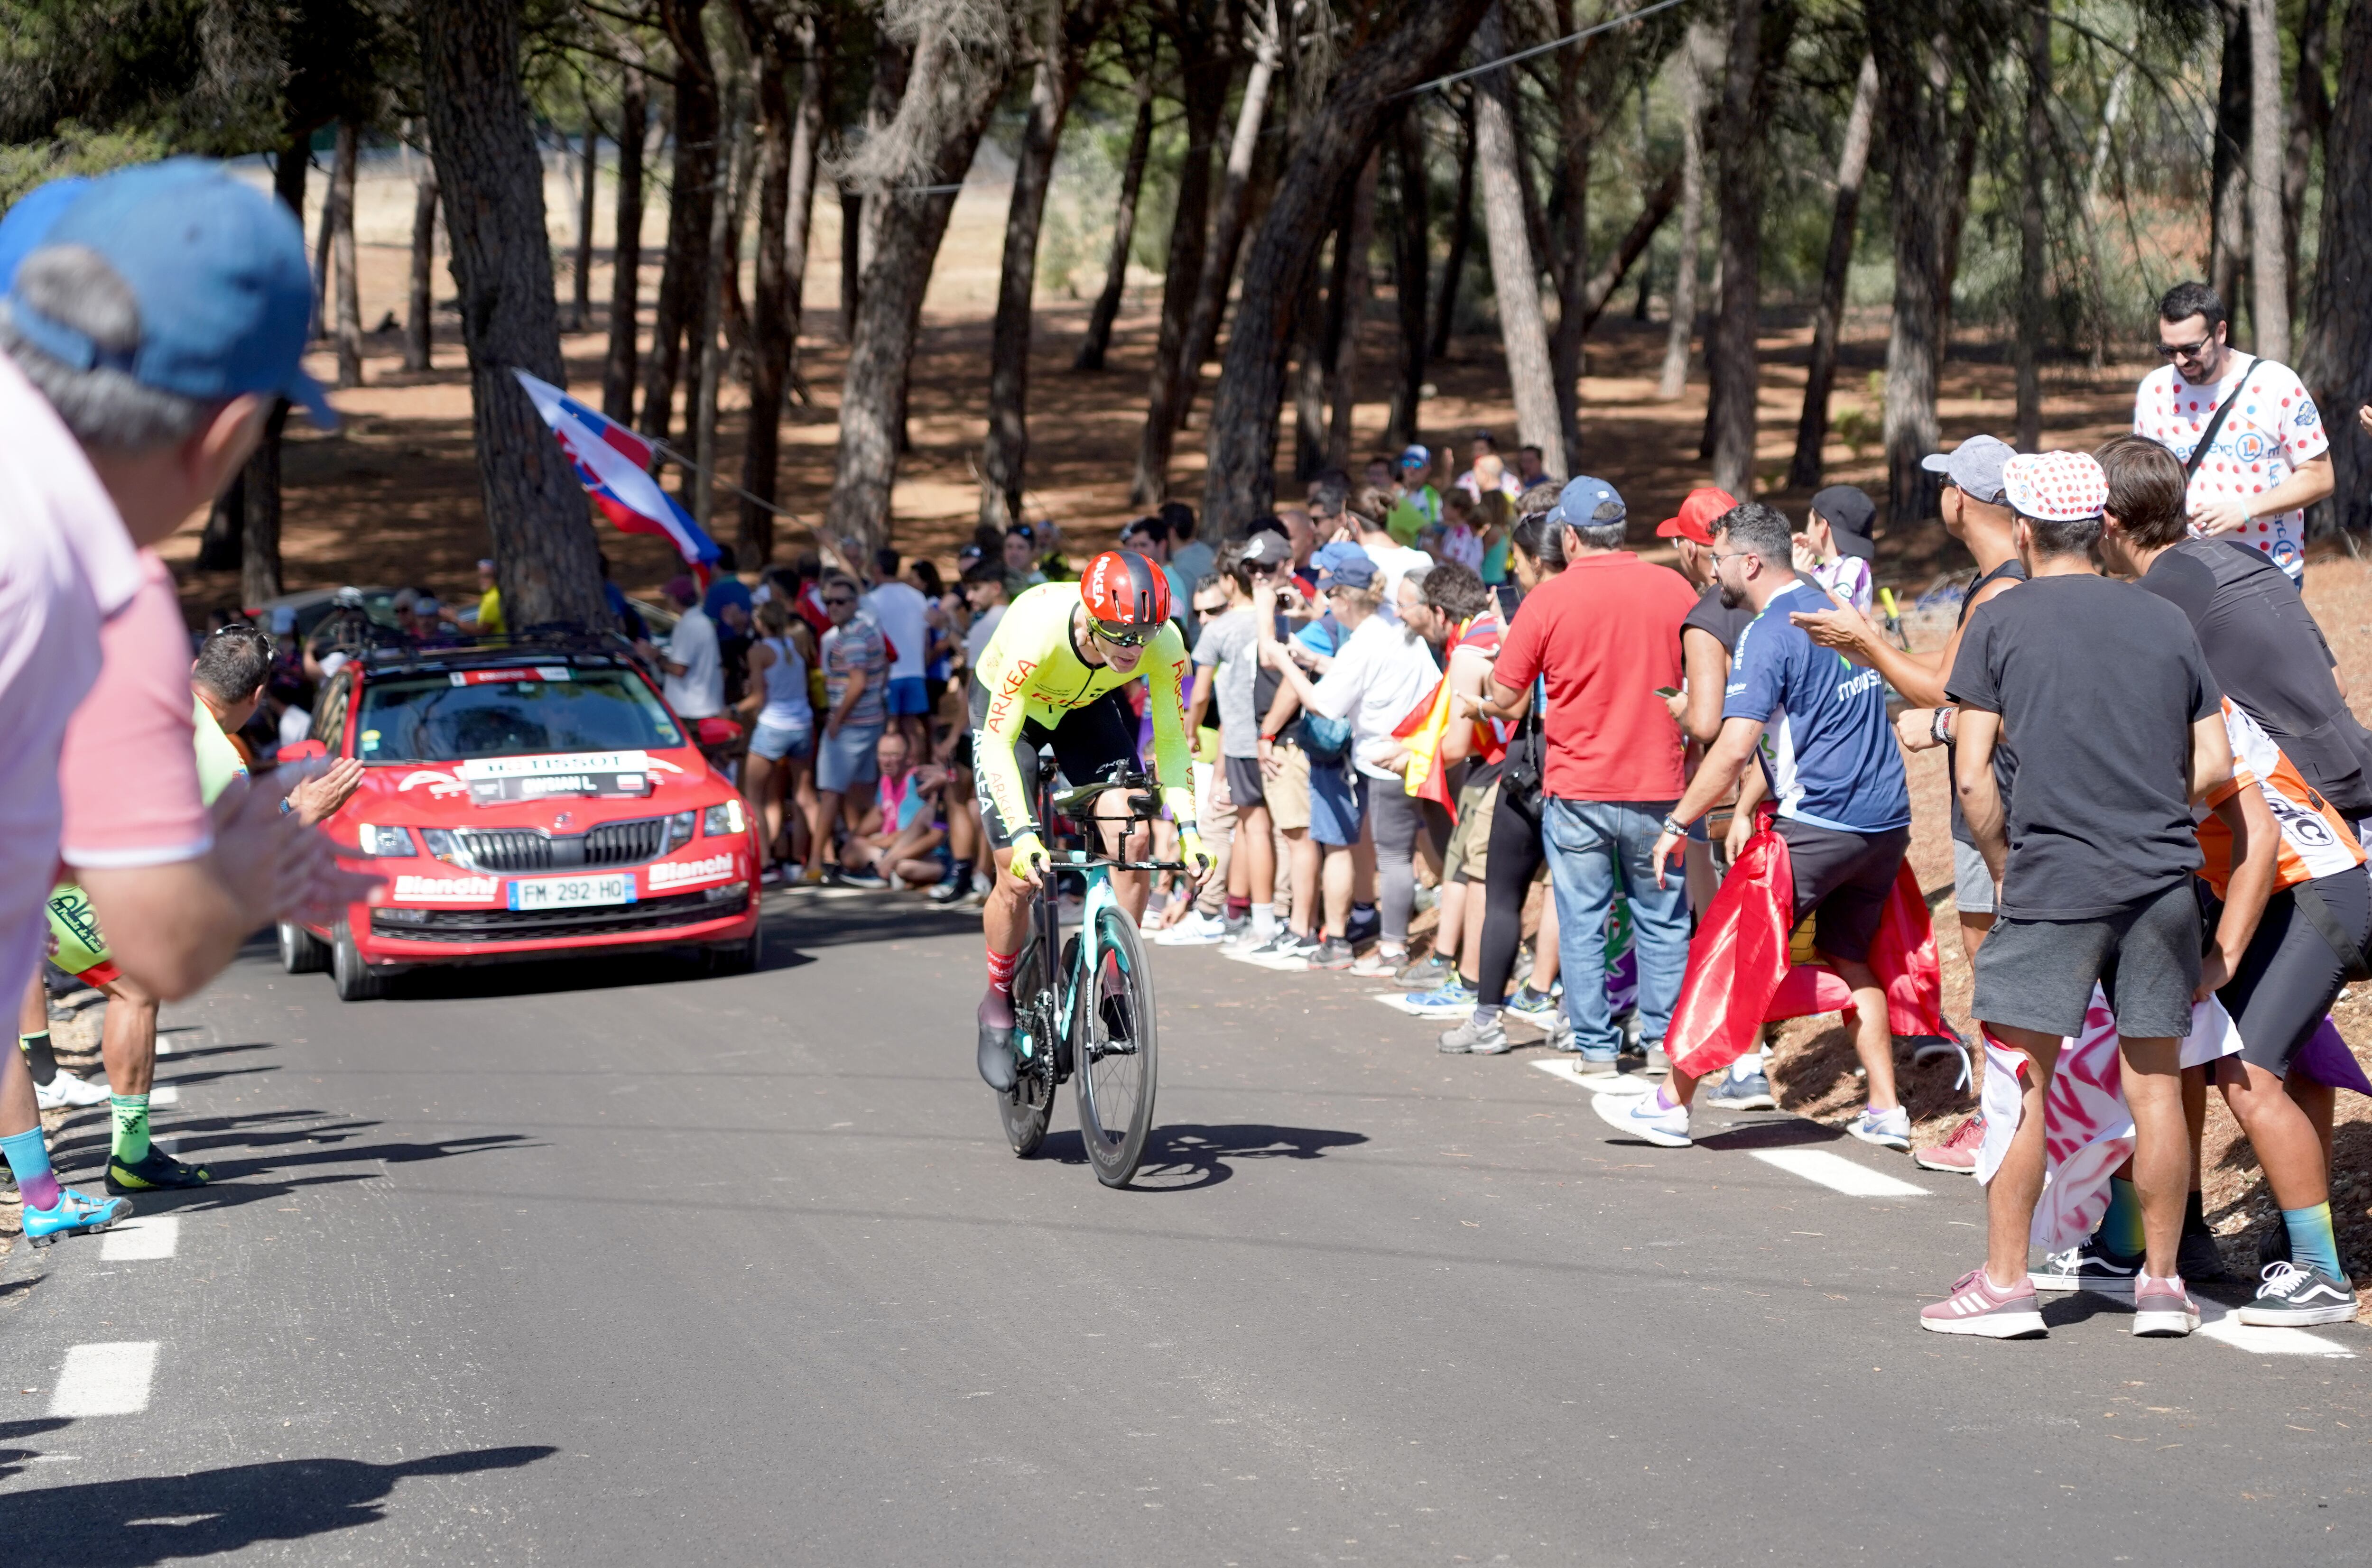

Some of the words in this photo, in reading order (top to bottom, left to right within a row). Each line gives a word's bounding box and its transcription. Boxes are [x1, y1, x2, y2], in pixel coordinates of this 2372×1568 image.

[1093, 556, 1111, 608] ARKEA
[989, 660, 1038, 733] ARKEA
[532, 756, 621, 770] TISSOT
[990, 773, 1016, 827] ARKEA
[394, 875, 499, 895] Bianchi
[648, 853, 733, 883] Bianchi
